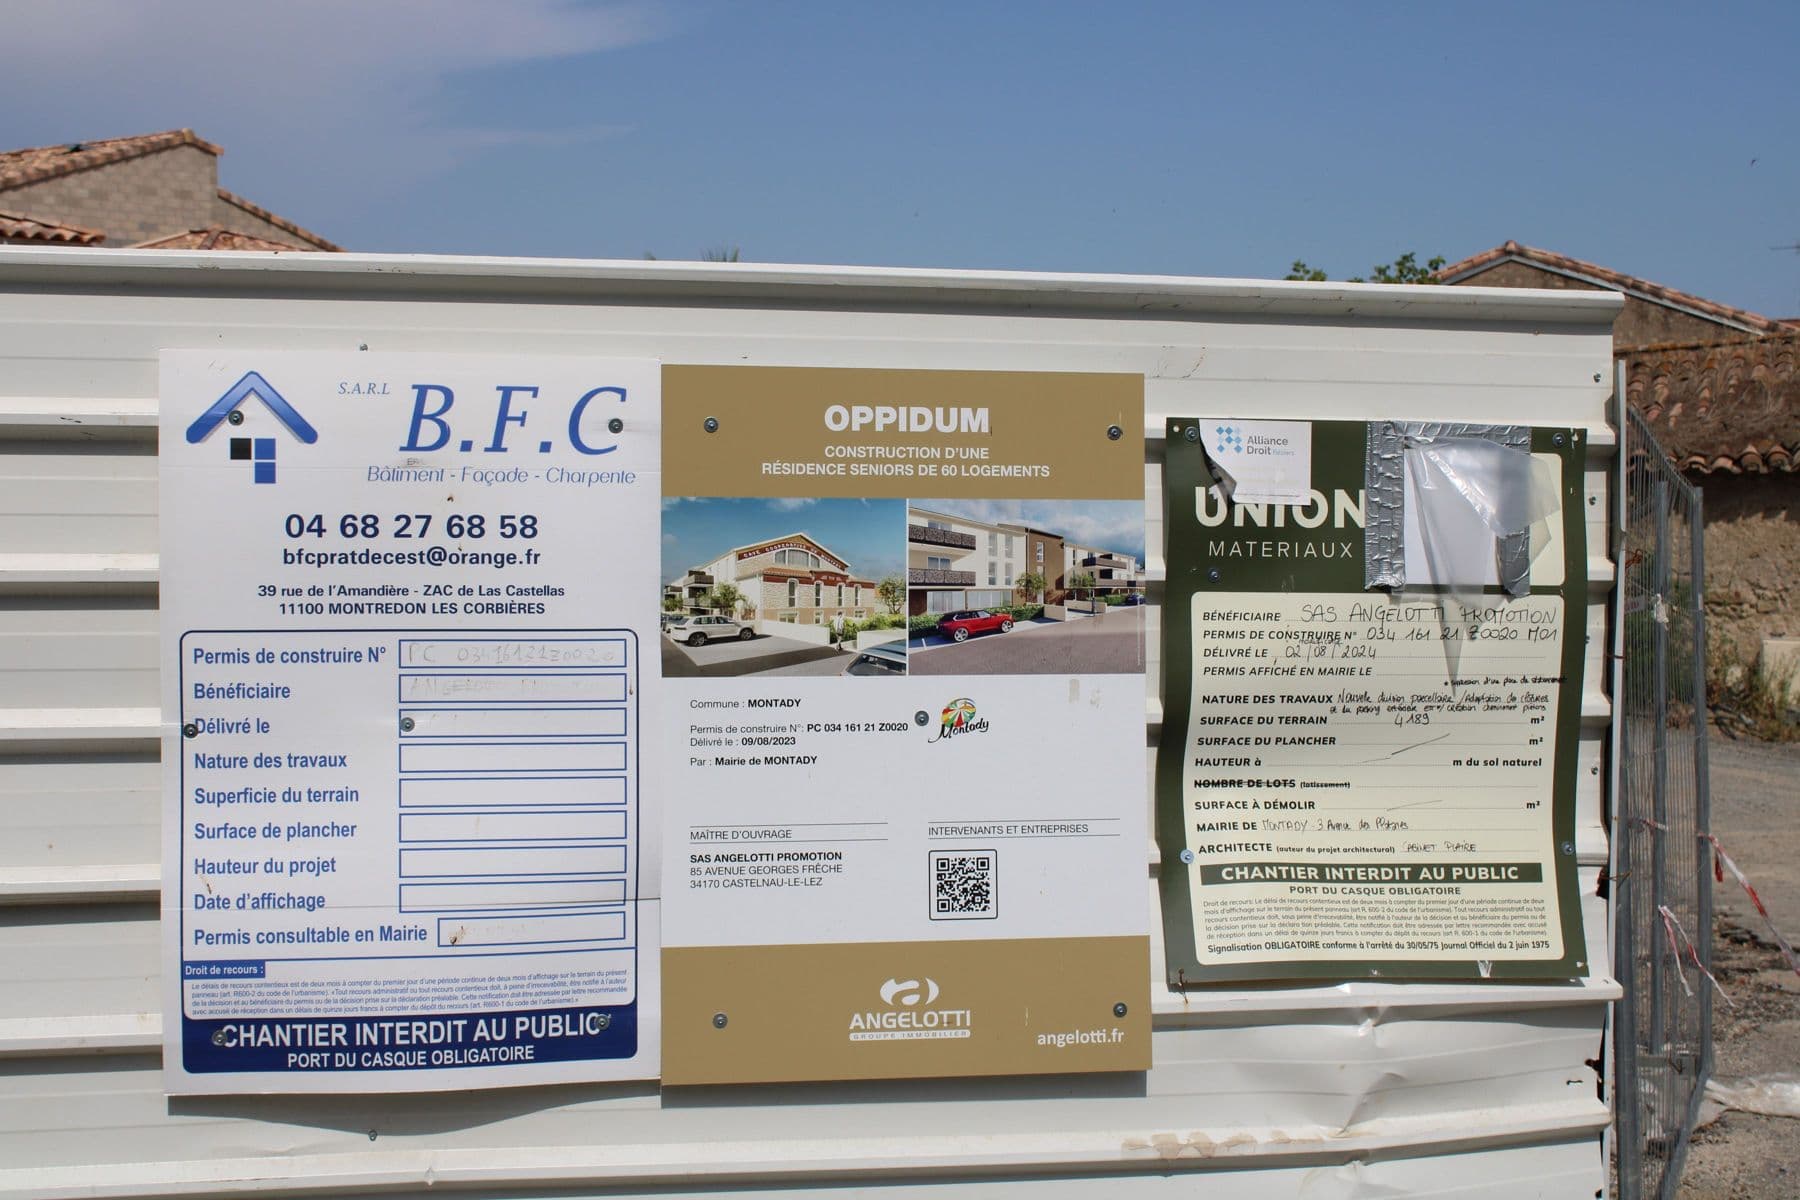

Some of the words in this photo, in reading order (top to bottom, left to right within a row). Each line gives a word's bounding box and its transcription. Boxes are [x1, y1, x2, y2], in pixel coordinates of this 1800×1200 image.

[338, 382, 389, 394] S.A.R.L
[398, 384, 626, 455] B.F.C
[824, 405, 988, 432] OPPIDUM
[1247, 435, 1288, 448] Alliance
[825, 446, 940, 458] CONSTRUCTION
[1247, 445, 1270, 454] Droit
[762, 460, 845, 474] RÉSIDENCE
[850, 464, 913, 475] SENIORS
[918, 464, 937, 475] DE
[941, 464, 957, 475] 60
[961, 464, 1049, 476] LOGEMENTS
[367, 465, 444, 481] Bâtiment
[461, 466, 528, 486] Façade
[546, 467, 635, 487] Charpente
[1195, 487, 1367, 528] UNION
[285, 514, 326, 538] 04
[340, 514, 379, 538] 68
[394, 514, 431, 537] 27
[446, 514, 485, 538] 68
[500, 515, 537, 538] 58
[1209, 541, 1352, 557] MATERIAUX
[284, 547, 540, 568] bfcpratdecest@orange.fr
[258, 585, 276, 596] 39
[281, 588, 302, 596] rue
[307, 585, 324, 596] de
[423, 584, 452, 595] ZAC
[458, 585, 473, 596] de
[478, 585, 500, 596] Las
[506, 585, 564, 596] Castellas
[280, 603, 323, 614] 11100
[329, 602, 425, 614] MONTREDON
[432, 602, 457, 614] LES
[464, 600, 544, 614] CORBIÈRES
[1202, 610, 1280, 621] BÉNÉFICIAIRE
[1203, 630, 1245, 638] PERMIS
[1249, 630, 1264, 639] DE
[1268, 631, 1340, 641] CONSTRUIRE
[194, 648, 249, 664] Permis
[256, 648, 274, 663] de
[280, 647, 362, 663] construire
[1204, 646, 1251, 657] DÉLIVRÉ
[1255, 649, 1267, 657] LE
[1203, 666, 1245, 675] PERMIS
[1249, 665, 1296, 675] AFFICHÉ
[1299, 667, 1314, 675] EN
[1317, 667, 1356, 675] MAIRIE
[1359, 667, 1372, 675] LE
[194, 682, 290, 698] Bénéficiaire
[690, 699, 740, 708] Commune
[748, 698, 800, 707] MONTADY
[1202, 695, 1248, 703] NATURE
[1253, 695, 1275, 703] DES
[1279, 695, 1332, 703] TRAVAUX
[194, 718, 250, 734] Délivré
[256, 718, 269, 733] le
[1200, 716, 1253, 724] SURFACE
[1257, 716, 1273, 724] DU
[1278, 716, 1327, 724] TERRAIN
[690, 725, 722, 733] Permis
[725, 725, 737, 733] de
[740, 725, 786, 733] construire
[807, 723, 821, 732] PC
[824, 723, 841, 732] 034
[845, 723, 860, 731] 161
[864, 723, 874, 731] 21
[878, 722, 908, 731] Z0020
[928, 718, 989, 743] Montady
[690, 738, 722, 746] Délivré
[741, 736, 795, 745] 09/08/2023
[1197, 737, 1250, 745] SURFACE
[1254, 737, 1270, 745] DU
[1275, 736, 1335, 745] PLANCHER
[195, 753, 248, 768] Nature
[253, 752, 281, 768] des
[287, 753, 346, 767] travaux
[690, 757, 706, 766] Par
[715, 757, 745, 765] Mairie
[749, 757, 761, 765] de
[764, 756, 817, 764] MONTADY
[1195, 758, 1250, 766] HAUTEUR
[1254, 757, 1261, 766] à
[194, 787, 276, 807] Superficie
[282, 786, 301, 802] du
[307, 786, 358, 802] terrain
[194, 822, 256, 839] Surface
[262, 822, 281, 838] de
[287, 821, 356, 841] plancher
[928, 826, 1004, 836] INTERVENANTS
[1006, 826, 1020, 834] ET
[1021, 824, 1089, 834] ENTREPRISES
[1196, 822, 1238, 832] MAIRIE
[1242, 822, 1256, 830] DE
[690, 829, 728, 839] MAÎTRE
[1198, 843, 1272, 853] ARCHITECTE
[690, 854, 711, 863] SAS
[714, 853, 773, 862] ANGELOTTI
[777, 852, 841, 861] PROMOTION
[194, 858, 258, 874] Hauteur
[264, 857, 283, 873] du
[290, 857, 336, 876] projet
[690, 867, 702, 875] 85
[704, 866, 745, 875] AVENUE
[748, 865, 798, 874] GEORGES
[1221, 866, 1318, 882] CHANTIER
[1325, 867, 1411, 880] INTERDIT
[1419, 867, 1444, 879] AU
[1452, 866, 1517, 879] PUBLIC
[690, 879, 719, 888] 34170
[722, 877, 822, 887] CASTELNAU-LE-LEZ
[1341, 887, 1384, 896] CASQUE
[194, 892, 230, 909] Date
[194, 928, 250, 945] Permis
[256, 926, 349, 943] consultable
[355, 930, 373, 941] en
[380, 925, 427, 941] Mairie
[1208, 942, 1262, 954] Signalisation
[1264, 941, 1320, 949] OBLIGATOIRE
[1394, 941, 1404, 949] du
[1406, 941, 1438, 949] 30/05/75
[1441, 941, 1467, 950] Journal
[1469, 940, 1495, 949] Officiel
[1515, 940, 1529, 950] juin
[1531, 940, 1549, 948] 1975
[185, 965, 207, 974] Droit
[209, 965, 220, 974] de
[223, 966, 257, 974] recours
[850, 1010, 971, 1029] ANGELOTTI
[222, 1023, 347, 1047] CHANTIER
[356, 1020, 467, 1045] INTERDIT
[473, 1018, 506, 1041] AU
[516, 1012, 602, 1038] PUBLIC
[1038, 1028, 1124, 1047] angelotti.fr
[288, 1053, 330, 1067] PORT
[335, 1052, 355, 1066] DU
[361, 1051, 426, 1066] CASQUE
[431, 1045, 536, 1064] OBLIGATOIRE
